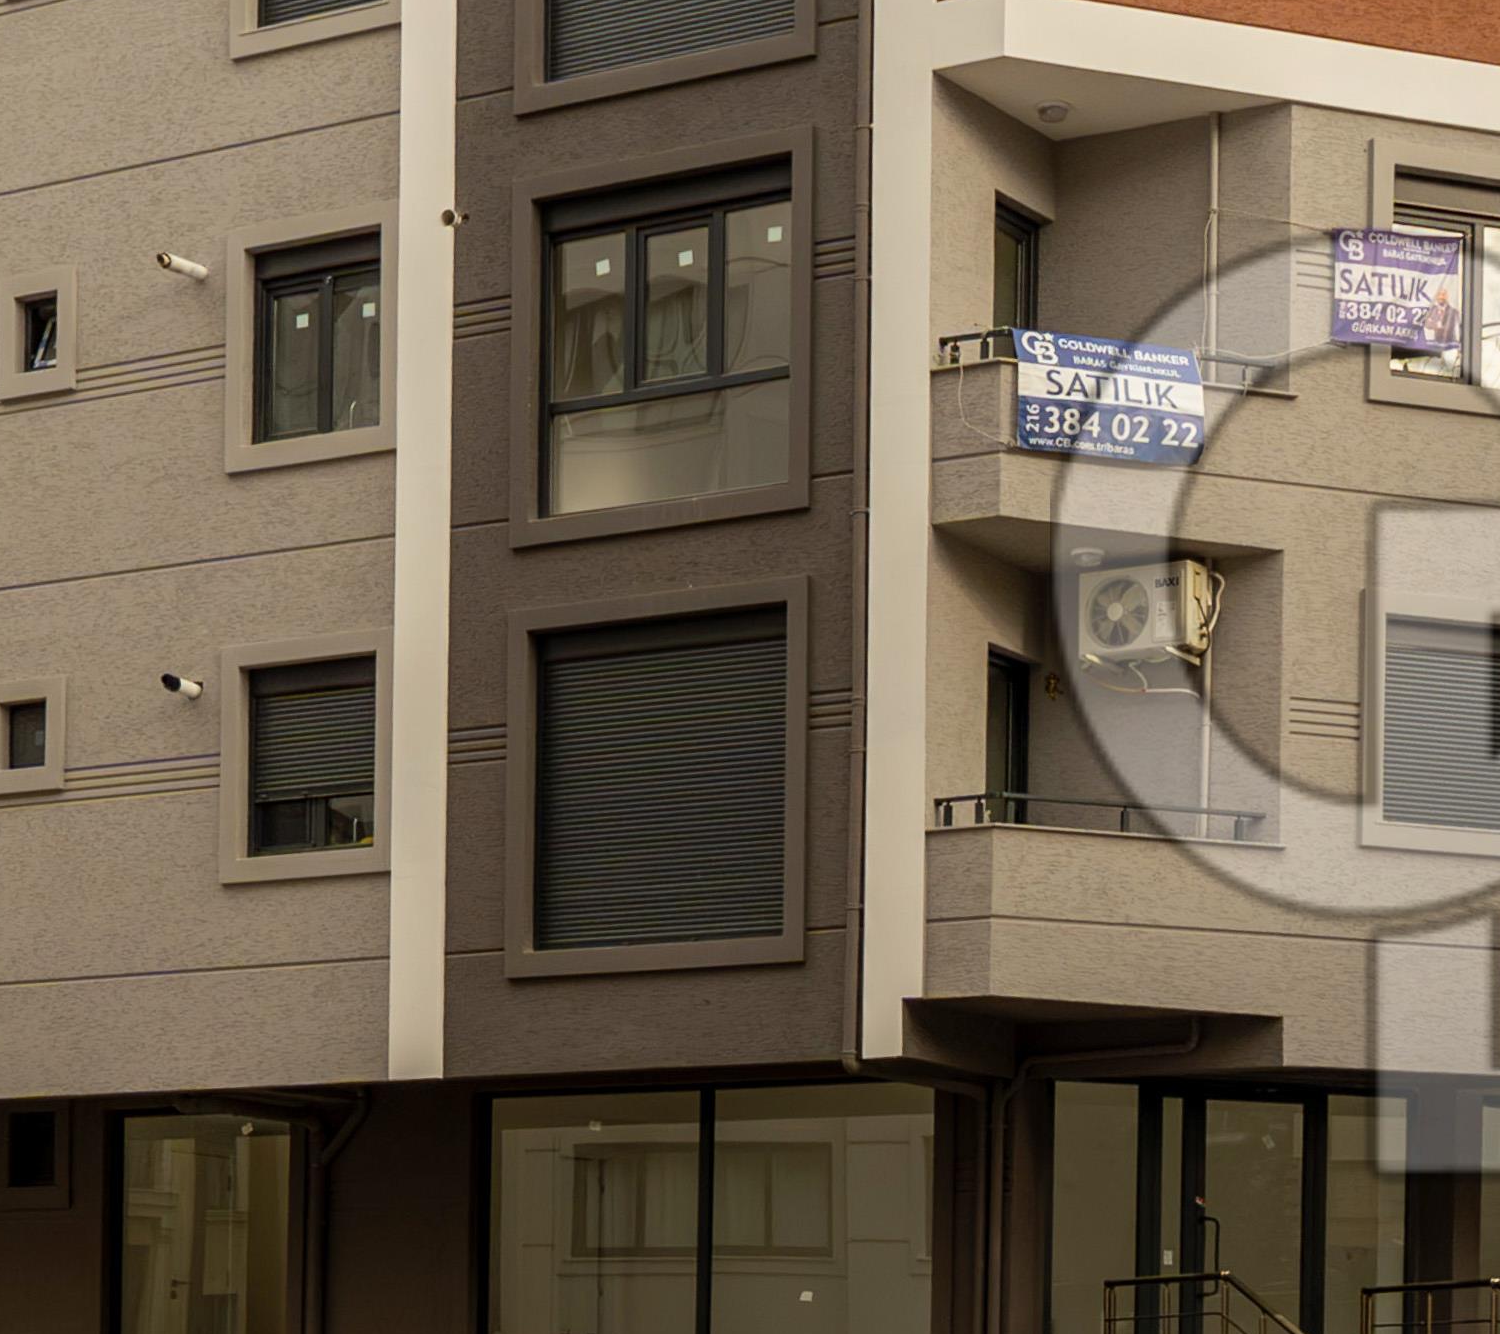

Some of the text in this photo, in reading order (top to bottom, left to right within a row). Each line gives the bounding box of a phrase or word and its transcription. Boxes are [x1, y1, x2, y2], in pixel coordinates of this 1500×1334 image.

[1339, 268, 1432, 302] SATILIK
[1346, 302, 1383, 320] 384
[1386, 304, 1408, 323] 02
[1058, 338, 1131, 360] COLDWELL
[1134, 350, 1190, 367] BANKER
[1046, 369, 1178, 409] SATILIK
[1025, 403, 1040, 433] 216
[1043, 405, 1199, 449] 384 02 22
